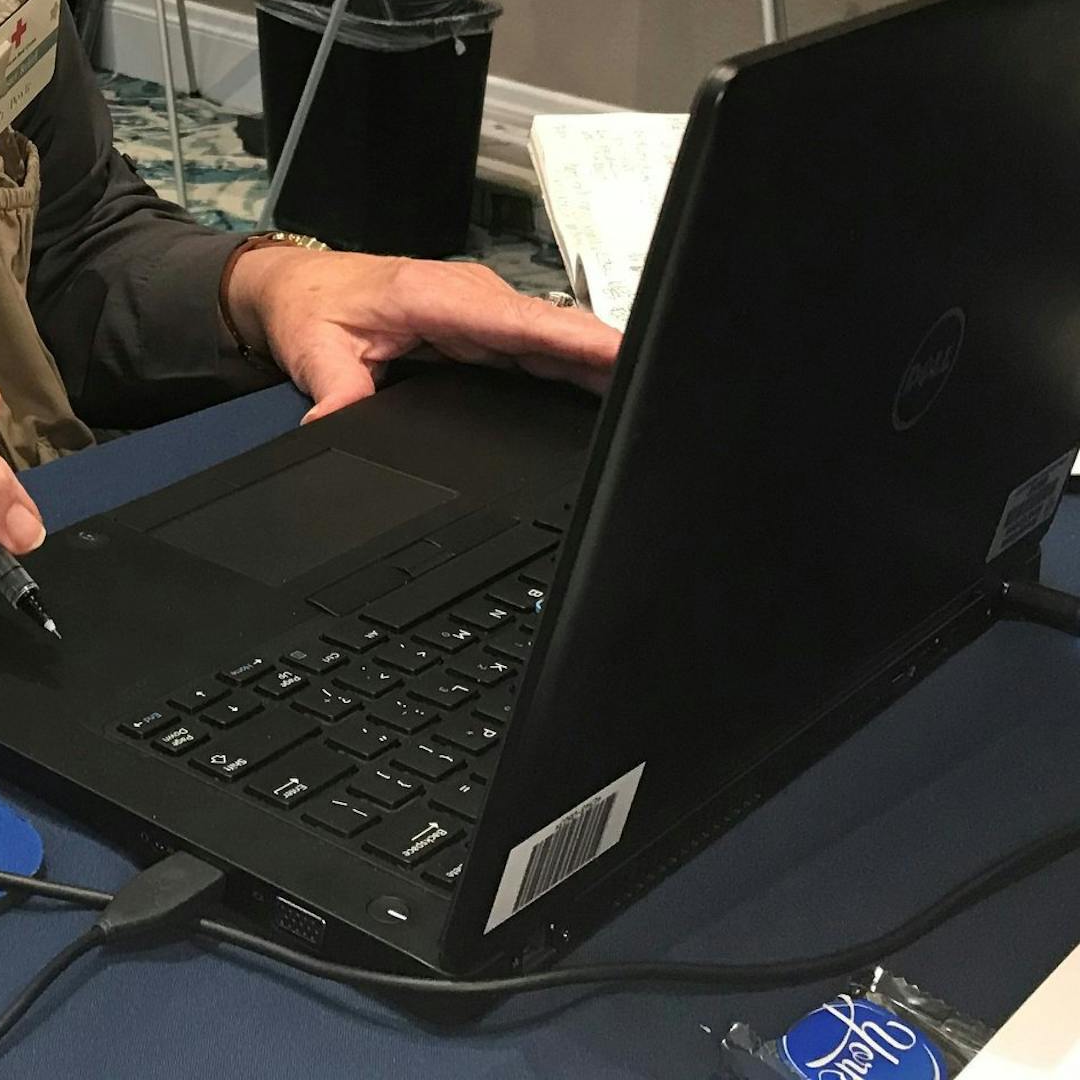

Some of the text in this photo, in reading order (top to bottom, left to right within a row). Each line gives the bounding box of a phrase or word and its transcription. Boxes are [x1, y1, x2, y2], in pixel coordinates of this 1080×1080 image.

[527, 588, 544, 598] B
[489, 608, 508, 619] N
[452, 629, 471, 640] M
[489, 662, 508, 672] K
[451, 684, 470, 692] L
[482, 728, 497, 738] P
[223, 758, 248, 772] Shift
[282, 783, 309, 799] Enter
[401, 828, 449, 857] Backspace
